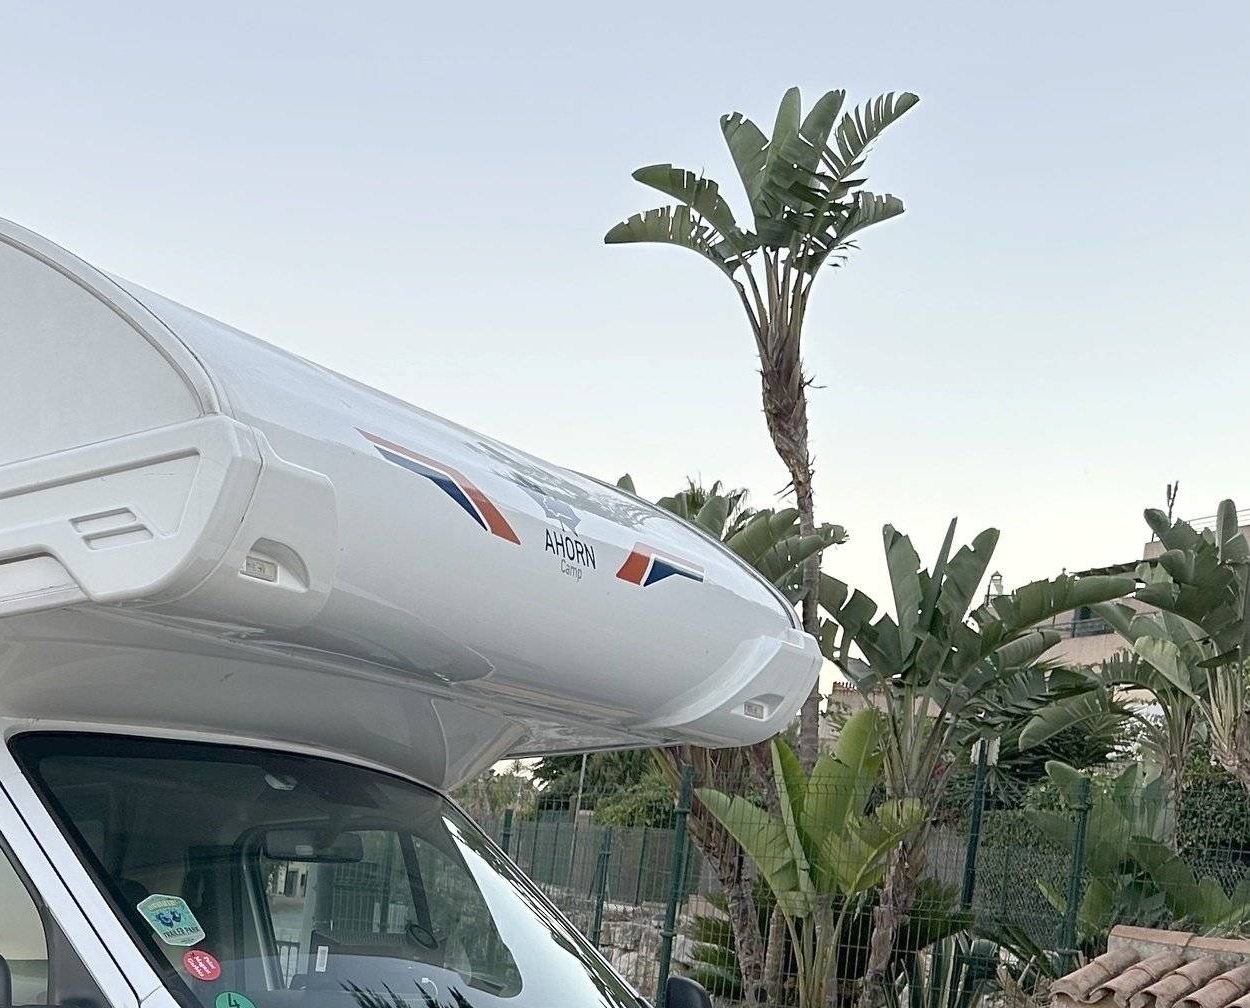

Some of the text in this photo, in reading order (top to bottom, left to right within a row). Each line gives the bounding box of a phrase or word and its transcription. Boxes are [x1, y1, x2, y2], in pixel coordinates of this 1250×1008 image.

[545, 528, 596, 570] AHORN
[560, 558, 582, 582] Camp
[227, 992, 240, 1008] 4
